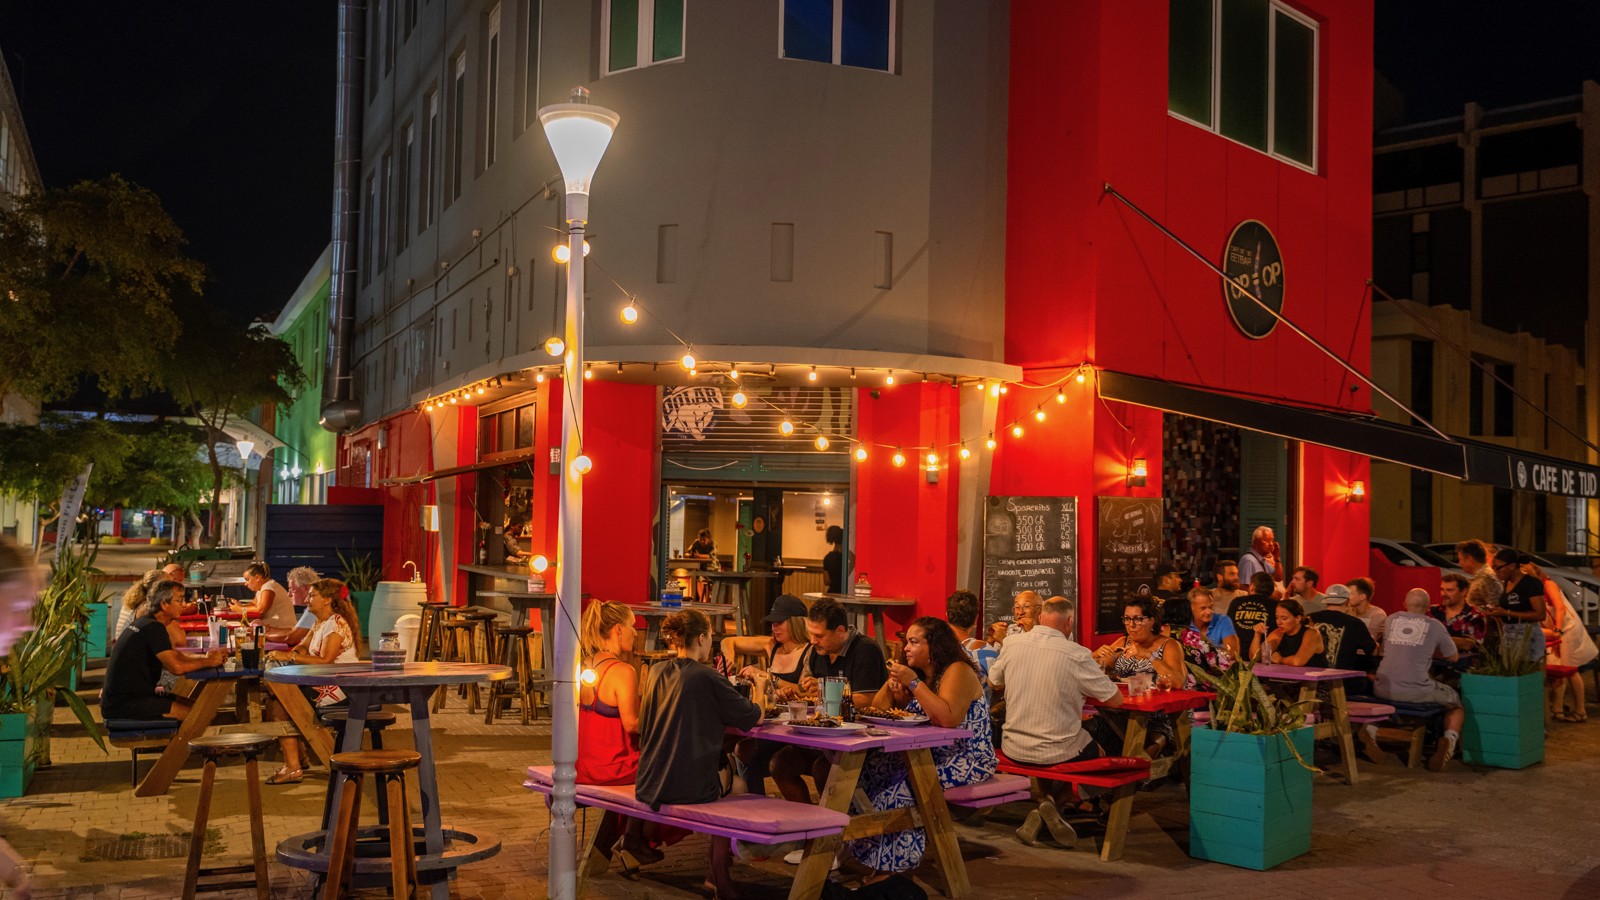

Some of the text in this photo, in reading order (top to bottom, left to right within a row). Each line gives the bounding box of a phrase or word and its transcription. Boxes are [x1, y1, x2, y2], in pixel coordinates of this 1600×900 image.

[1262, 262, 1281, 287] OP
[1532, 464, 1558, 492] CAFE
[1561, 469, 1575, 495] DE
[1015, 515, 1034, 526] 350
[1015, 525, 1032, 534] 500
[1015, 533, 1033, 543] 750
[1235, 610, 1269, 621] ETNIES
